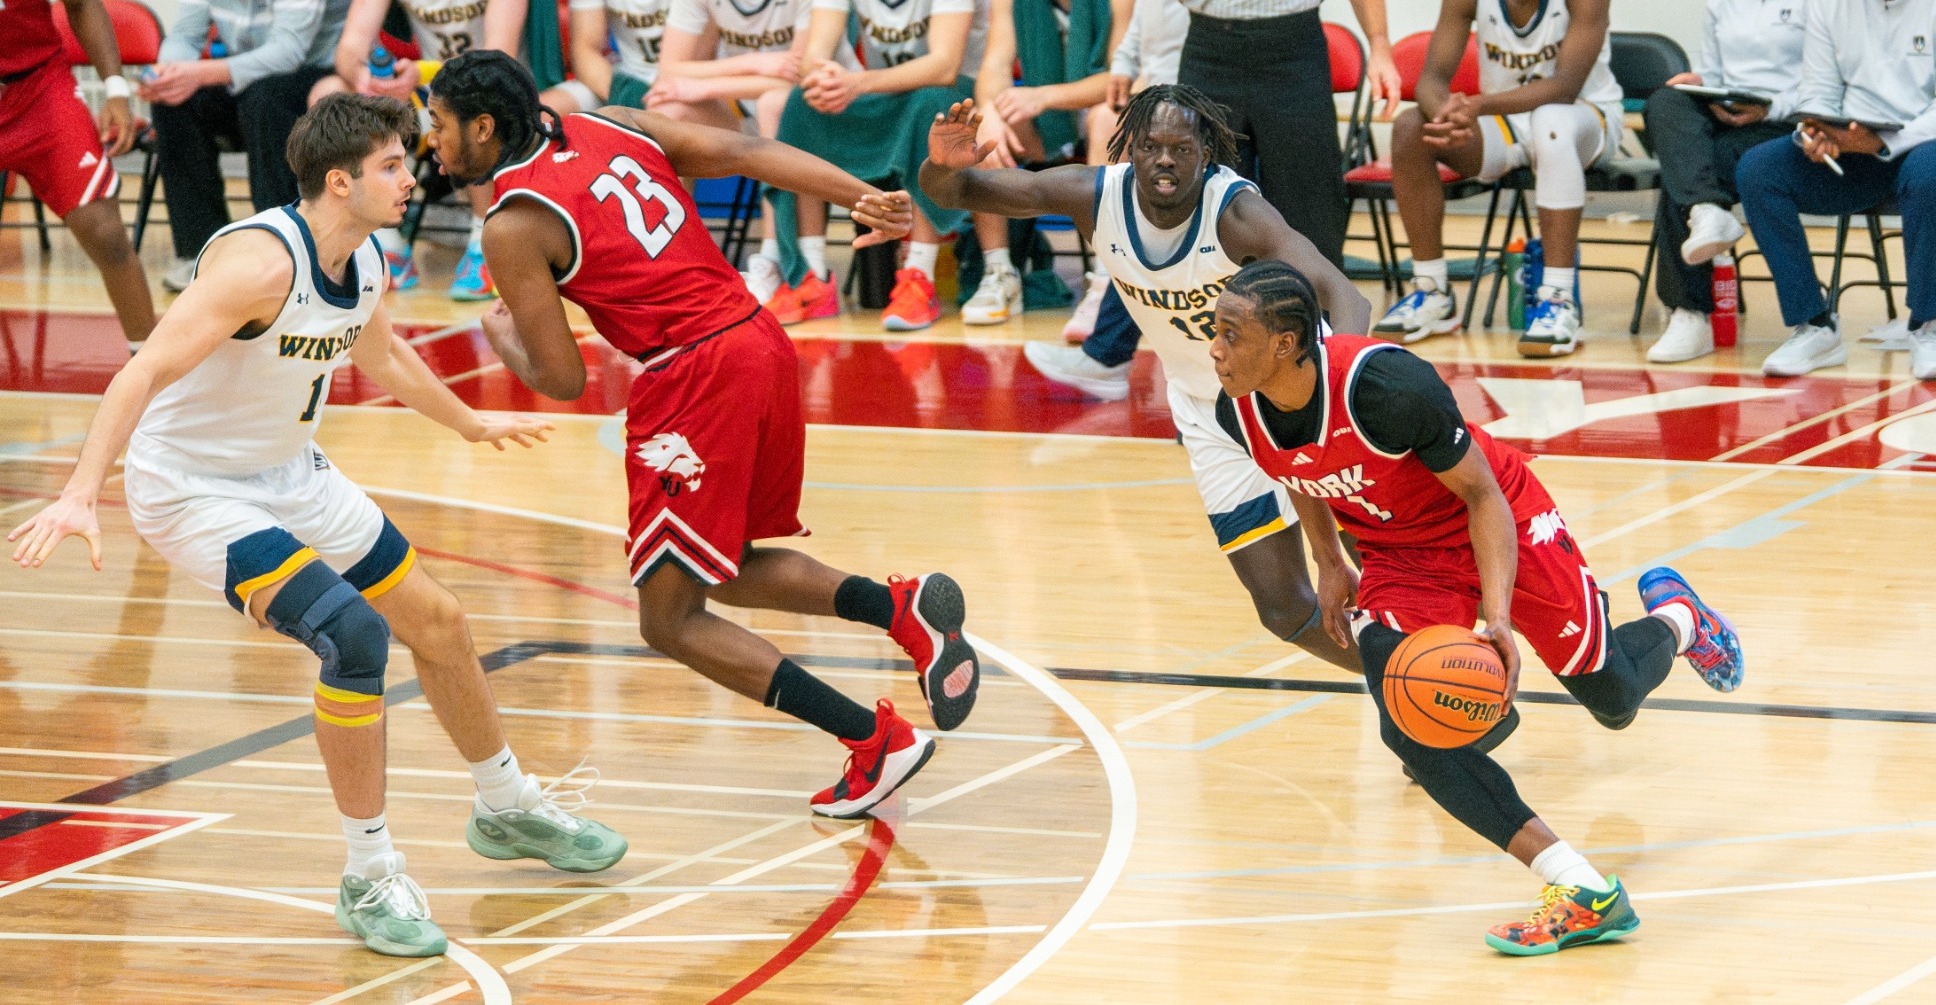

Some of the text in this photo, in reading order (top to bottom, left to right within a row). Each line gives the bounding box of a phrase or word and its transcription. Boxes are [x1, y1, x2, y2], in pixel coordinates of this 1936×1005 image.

[588, 153, 687, 261] 23
[298, 373, 326, 423] 1
[658, 475, 682, 498] YU
[1277, 463, 1377, 498] YORK
[1345, 494, 1394, 525] 1
[1433, 689, 1502, 722] Wilson
